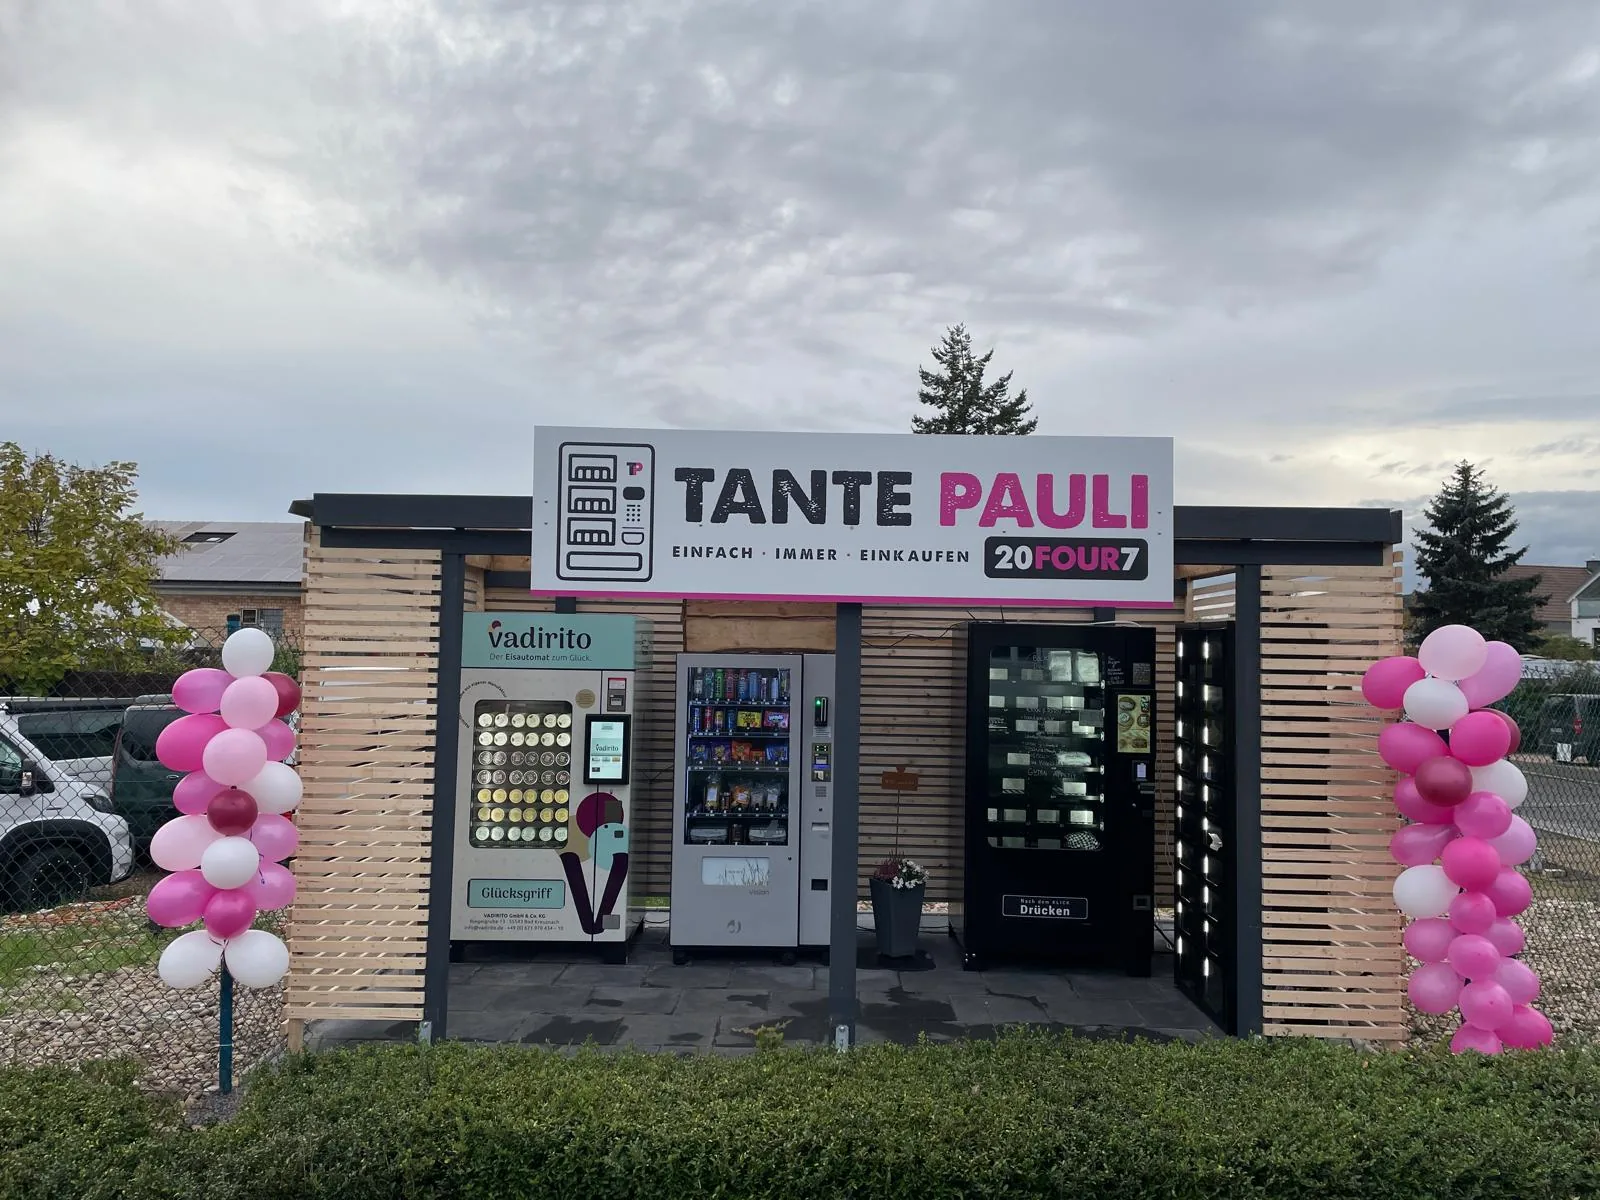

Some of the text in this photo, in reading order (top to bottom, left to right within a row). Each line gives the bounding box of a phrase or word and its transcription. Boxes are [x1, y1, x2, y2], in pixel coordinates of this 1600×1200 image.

[674, 467, 1149, 529] TANTE PAULI
[672, 545, 969, 563] EINFACH IMMER EINKAUFEN
[994, 544, 1140, 571] 20FOUR7
[488, 626, 592, 649] vadirito
[489, 653, 503, 661] Der
[505, 653, 549, 661] Eisautomat
[481, 887, 553, 902] Glücksgriff
[1020, 905, 1070, 916] Drücken
